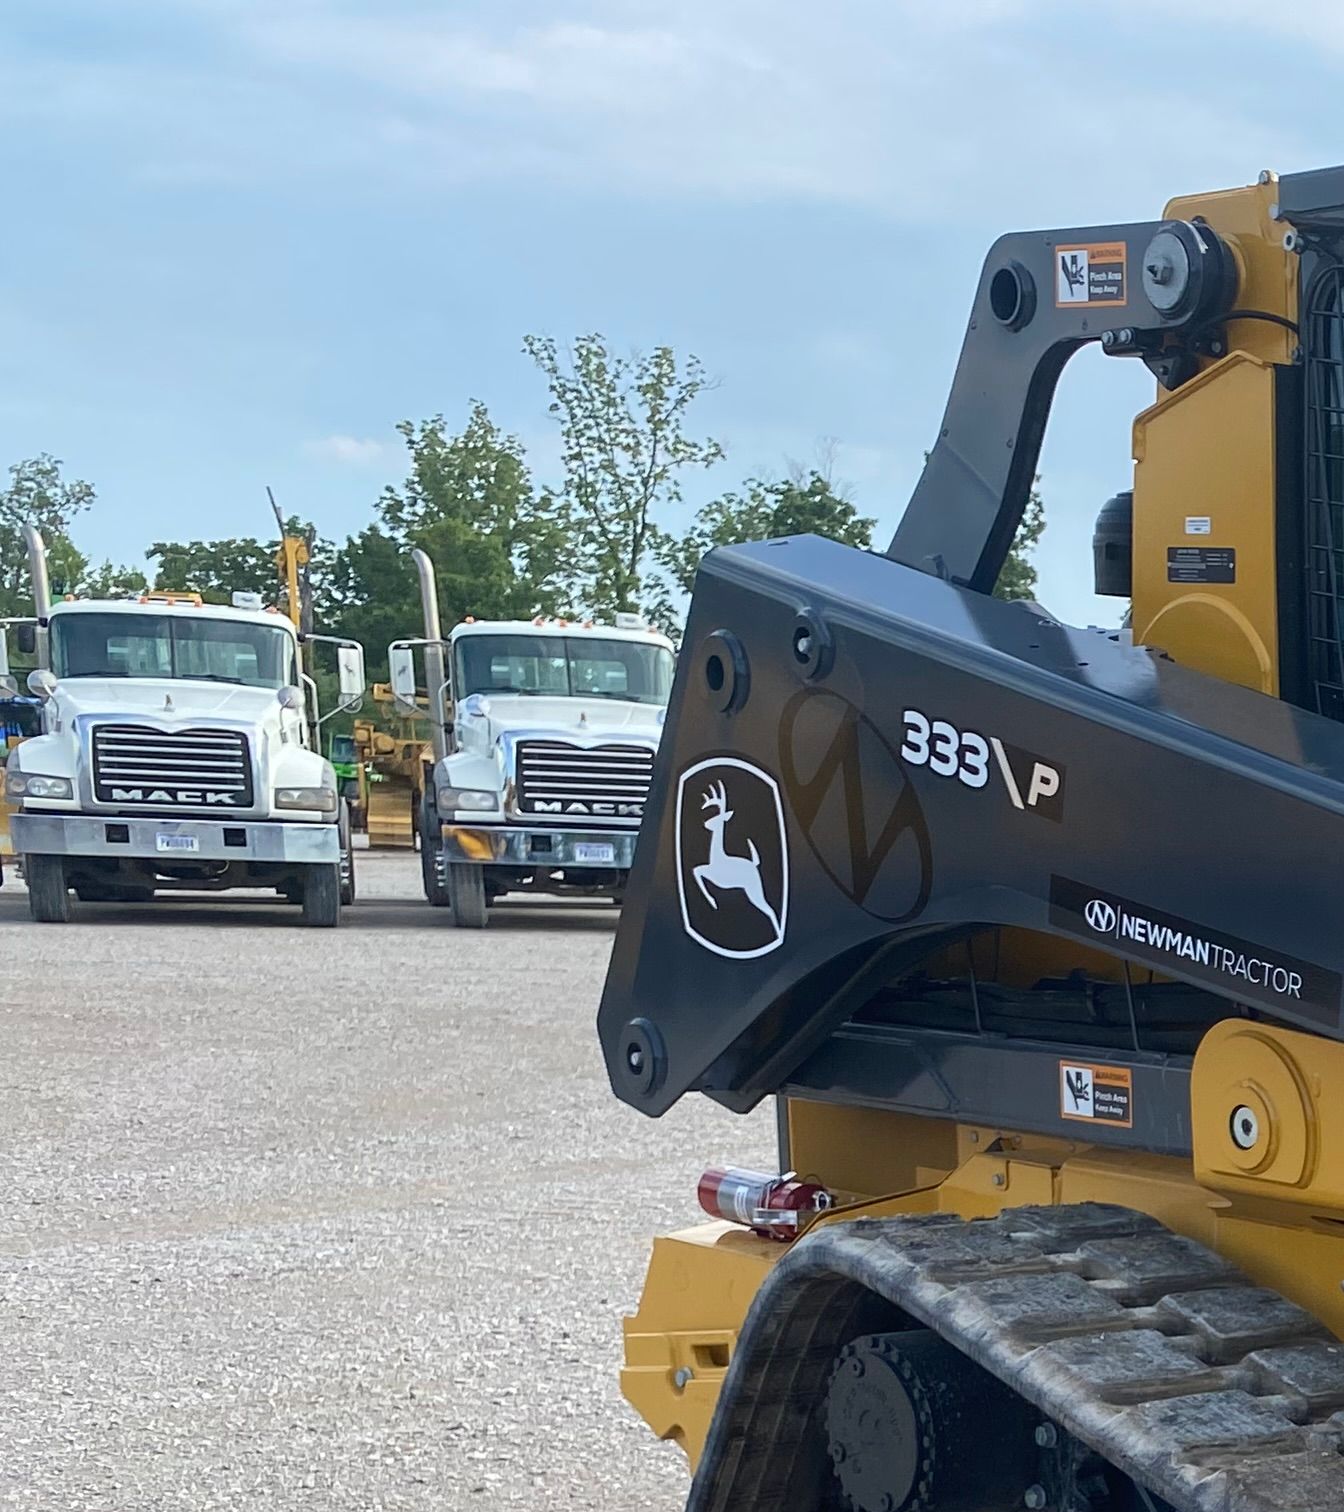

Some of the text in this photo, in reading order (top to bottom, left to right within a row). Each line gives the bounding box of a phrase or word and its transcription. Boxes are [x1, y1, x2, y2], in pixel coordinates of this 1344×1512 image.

[111, 788, 236, 804] MACK
[534, 800, 645, 816] MACK
[1121, 913, 1303, 999] NEWMANTRACTOR
